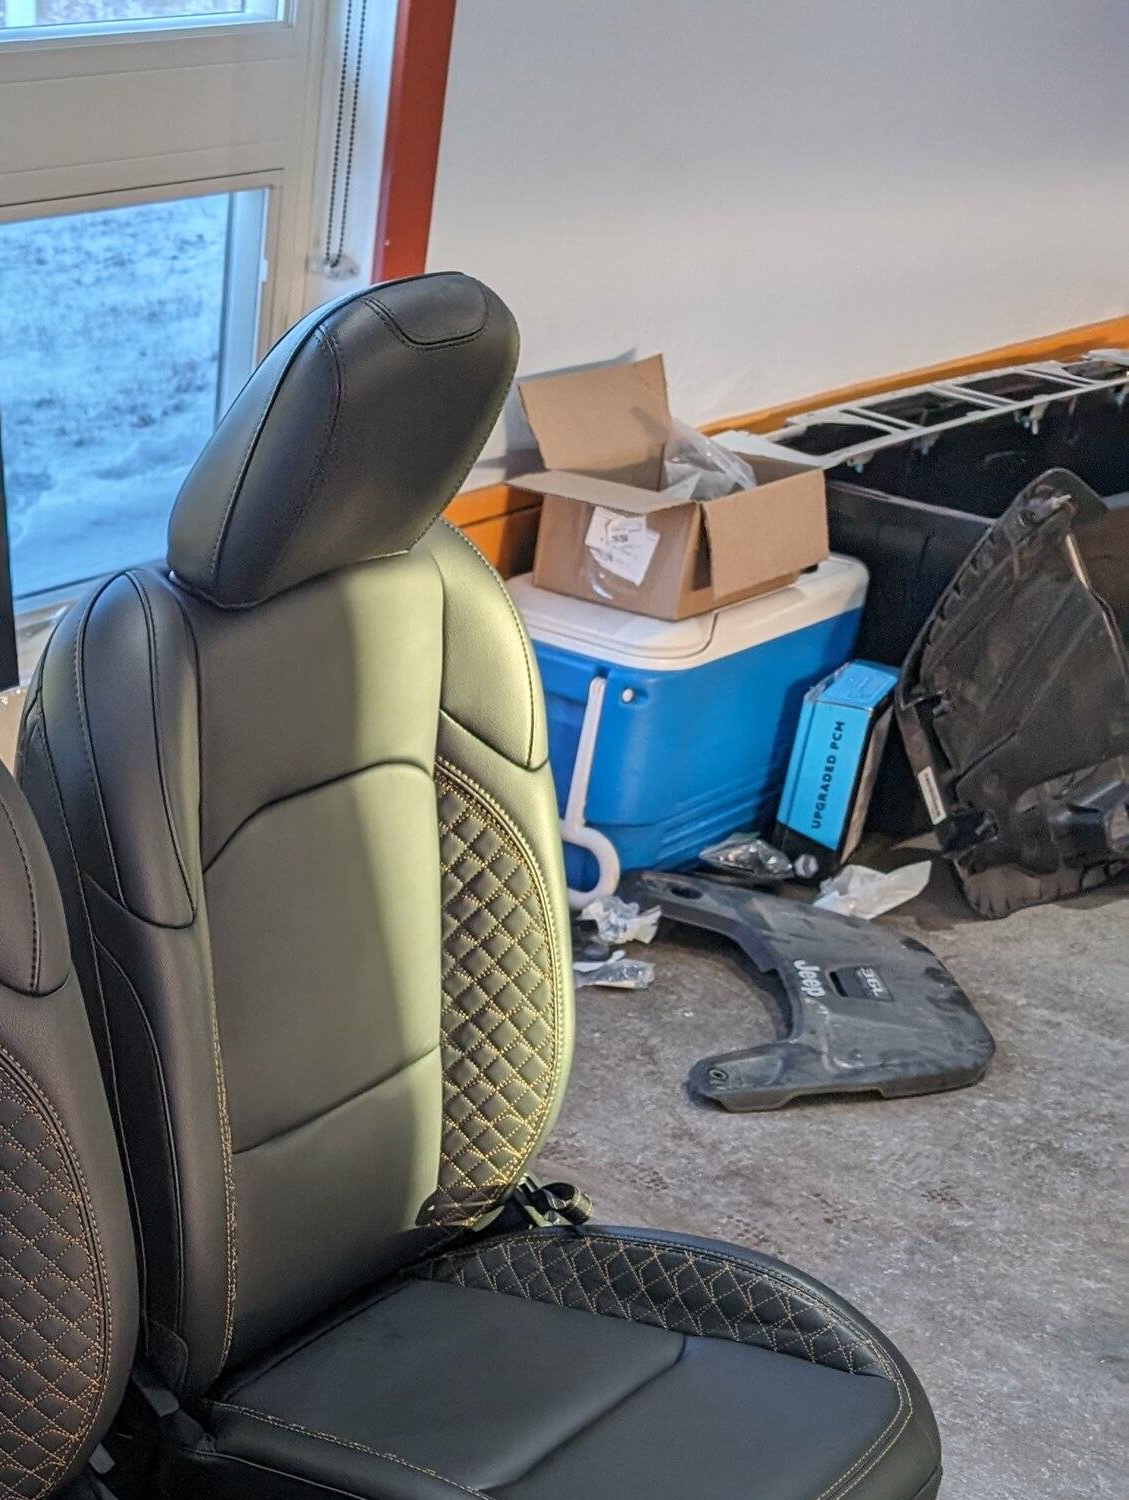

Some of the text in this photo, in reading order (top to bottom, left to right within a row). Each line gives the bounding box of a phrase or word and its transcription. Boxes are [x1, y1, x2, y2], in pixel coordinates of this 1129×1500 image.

[811, 721, 846, 829] UPGRADED PCM
[793, 959, 826, 997] Jeep
